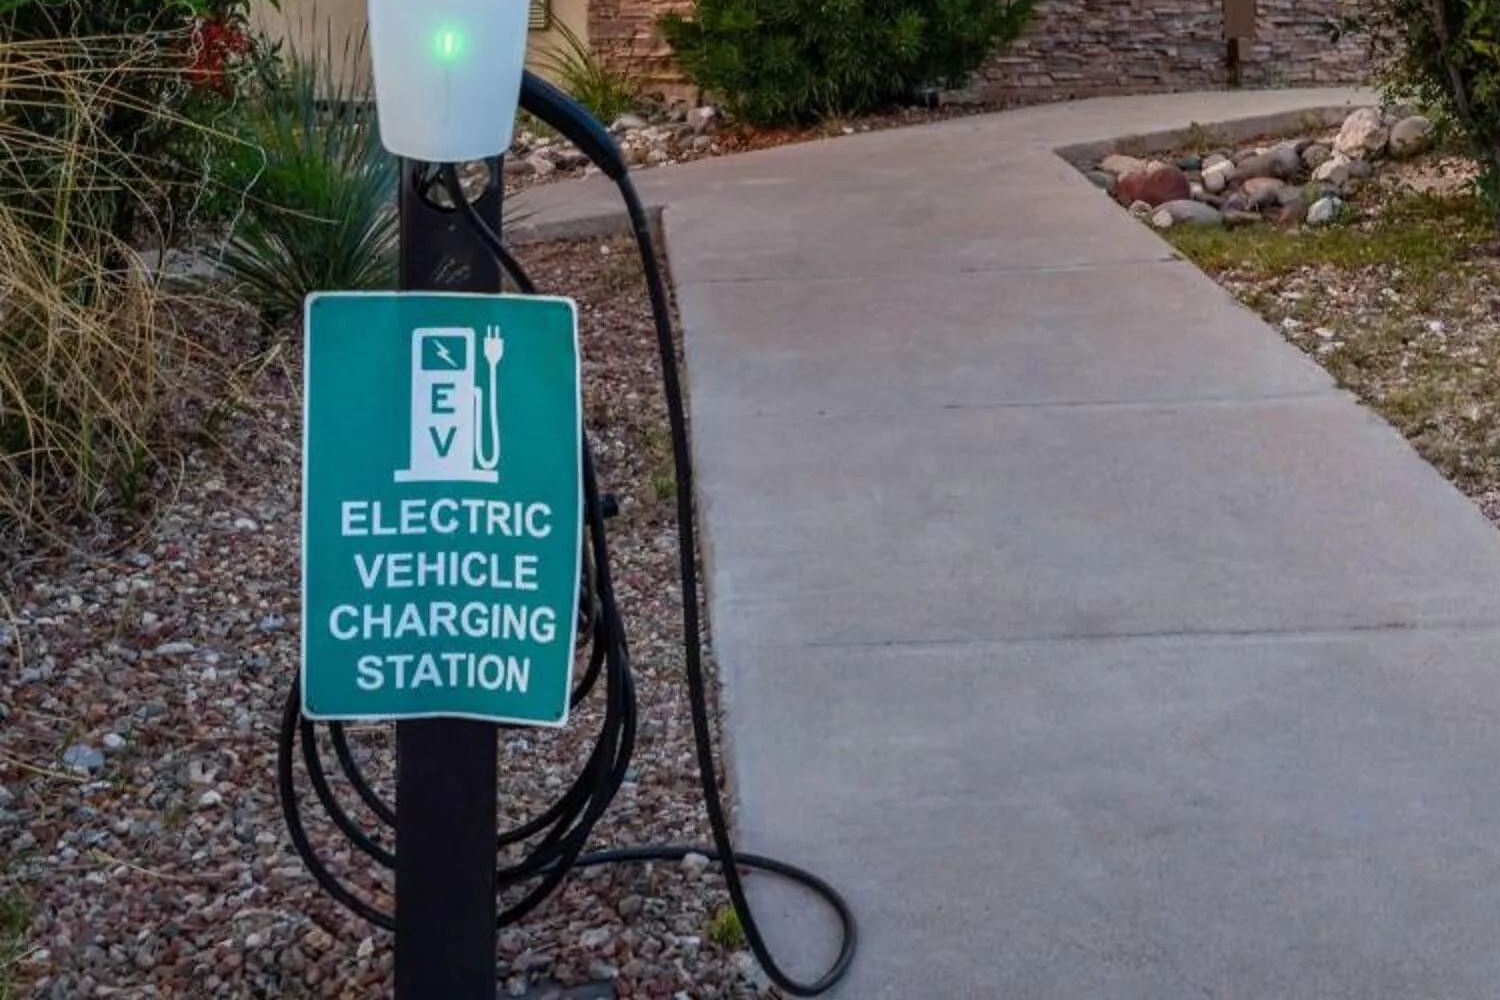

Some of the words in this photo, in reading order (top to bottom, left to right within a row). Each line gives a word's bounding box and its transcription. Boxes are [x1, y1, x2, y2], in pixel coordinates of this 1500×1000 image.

[429, 383, 457, 457] EV
[341, 499, 552, 538] ELECTRIC
[354, 552, 539, 590] VEHICLE
[328, 602, 556, 644] CHARGING
[356, 653, 531, 694] STATION
